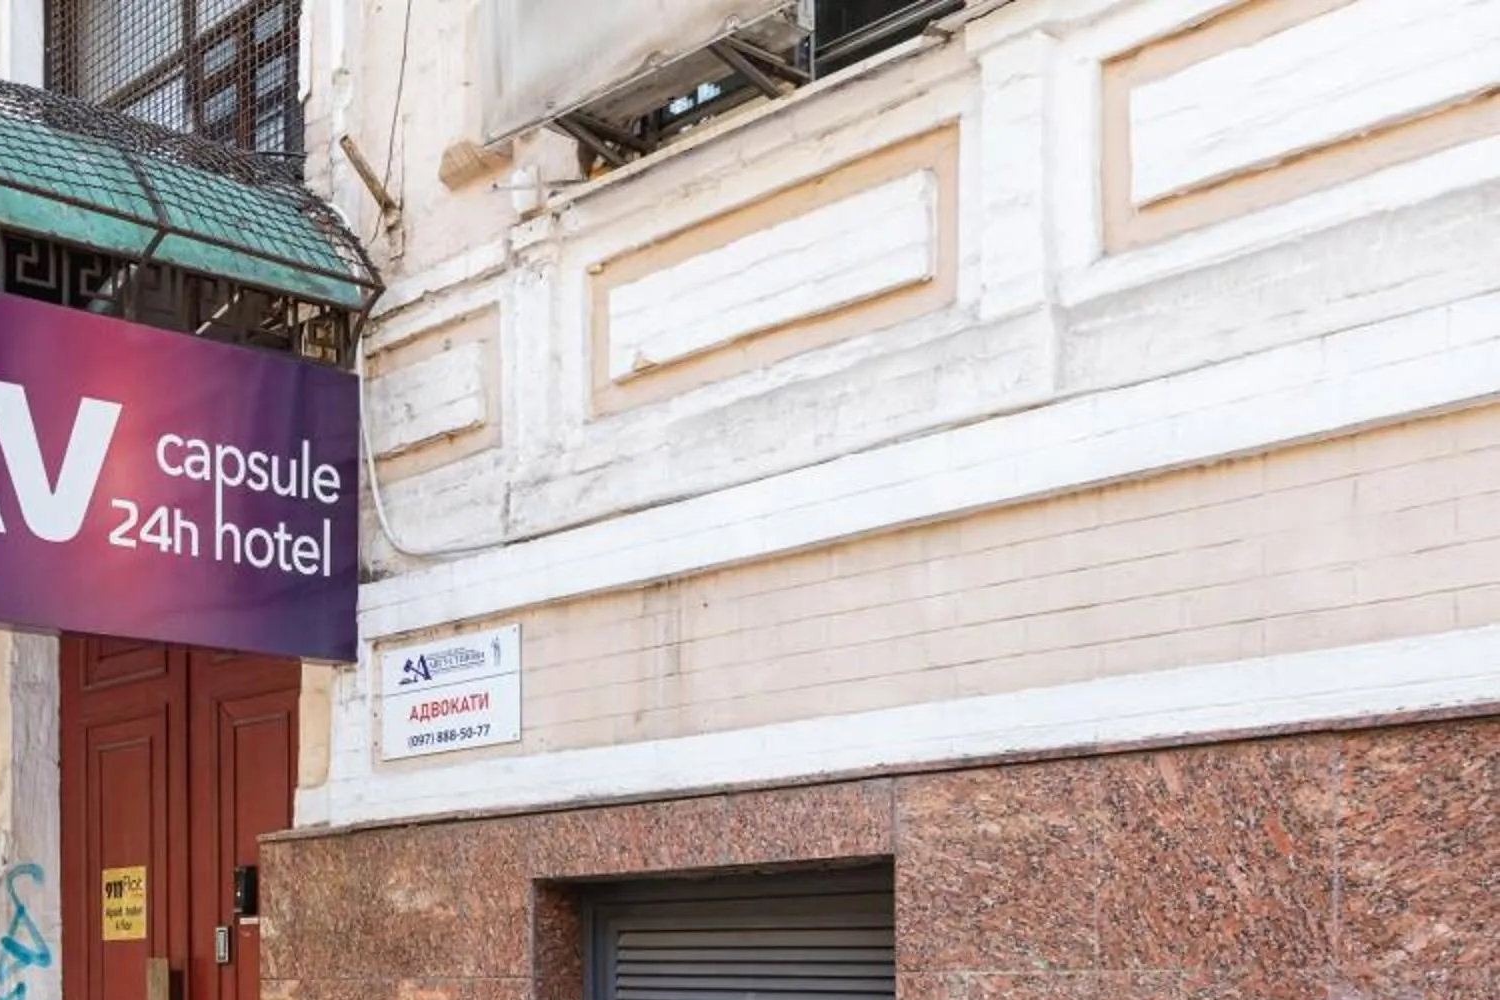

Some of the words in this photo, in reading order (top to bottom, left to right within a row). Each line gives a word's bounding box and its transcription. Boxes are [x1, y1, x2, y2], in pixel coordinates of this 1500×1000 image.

[156, 431, 341, 510] capsule
[108, 498, 199, 557] 24h
[214, 505, 332, 578] hotel
[409, 692, 489, 723] АДВОКАТИ
[408, 732, 435, 748] (097)
[436, 724, 491, 743] 888-50-77
